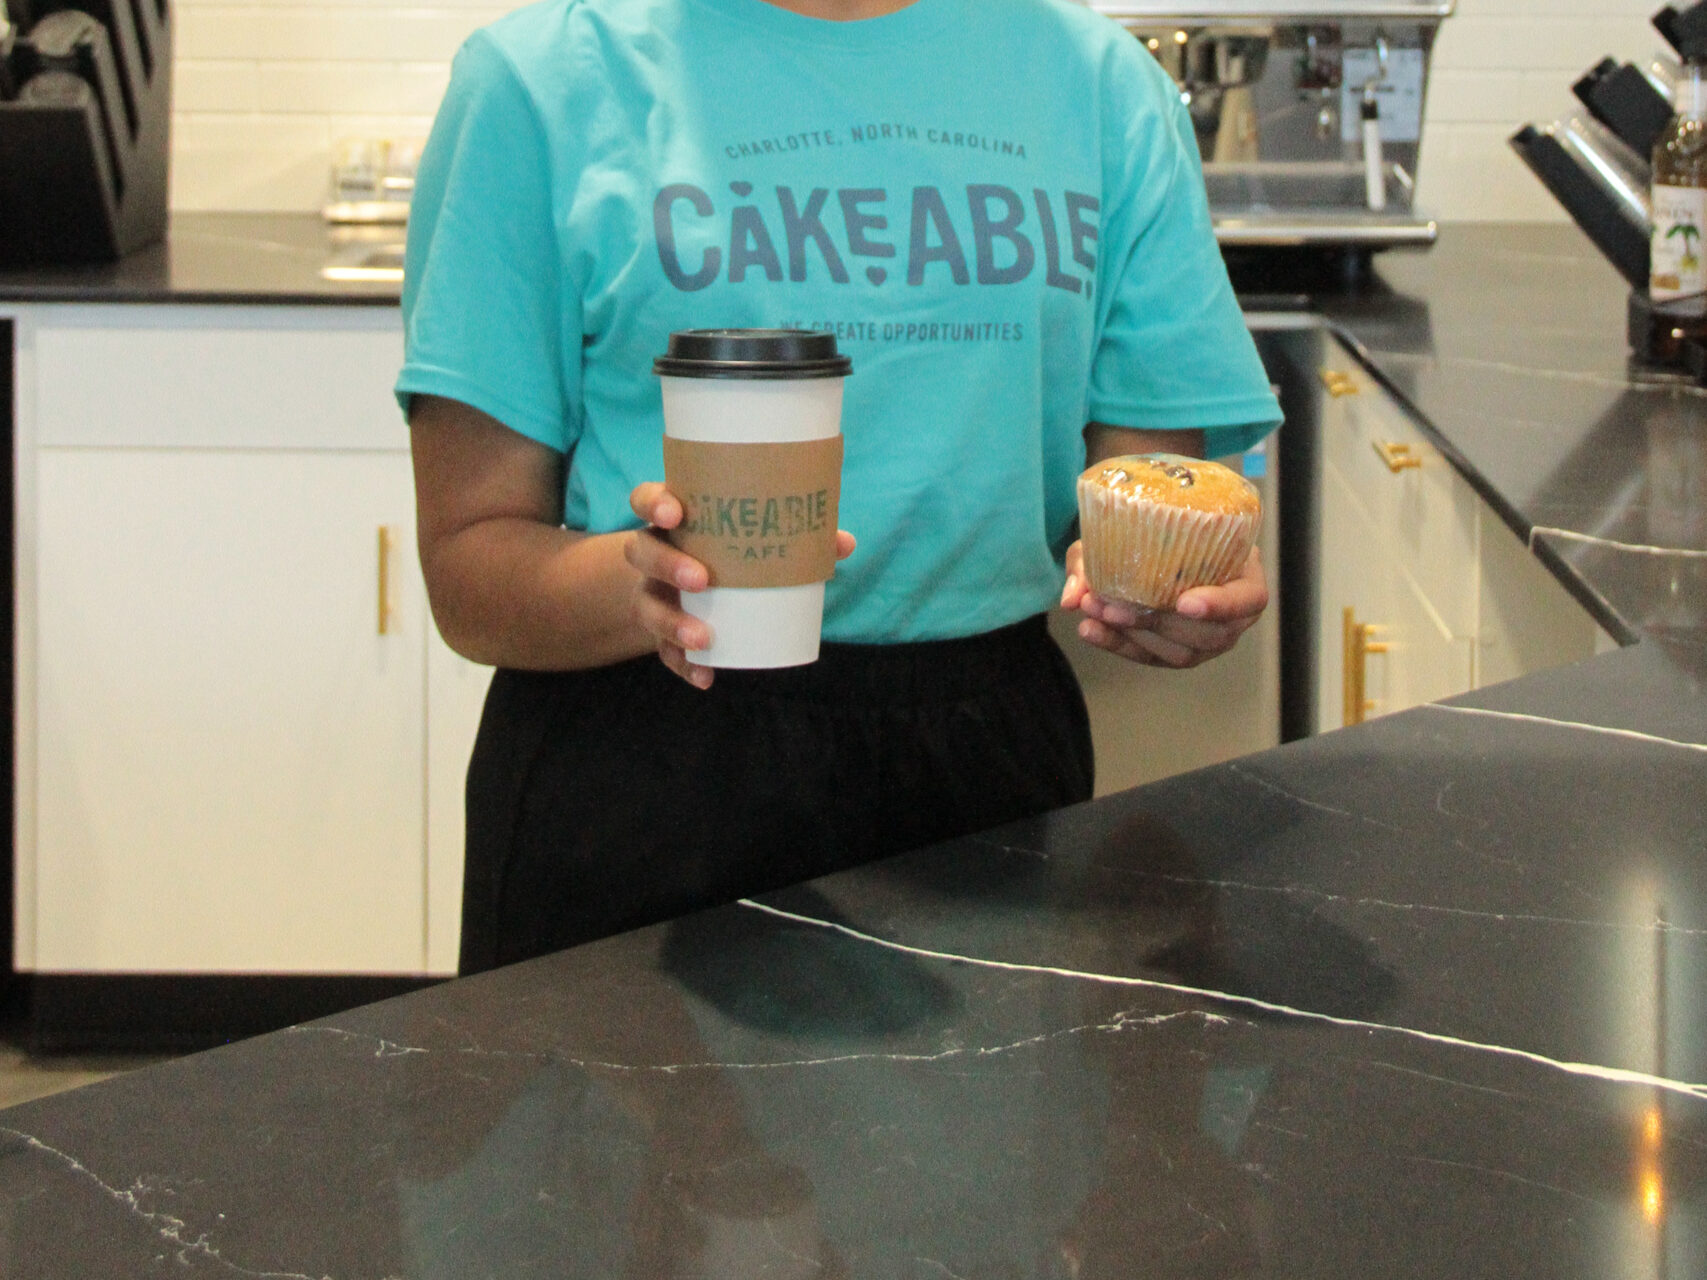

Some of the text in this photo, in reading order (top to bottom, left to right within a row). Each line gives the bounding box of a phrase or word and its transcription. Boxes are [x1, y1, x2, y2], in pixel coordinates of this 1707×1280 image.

[851, 123, 918, 143] NORTH
[928, 128, 1027, 159] CAROLINA
[653, 181, 1100, 297] CAKEABLE
[883, 322, 1023, 341] OPPORTUNITIES
